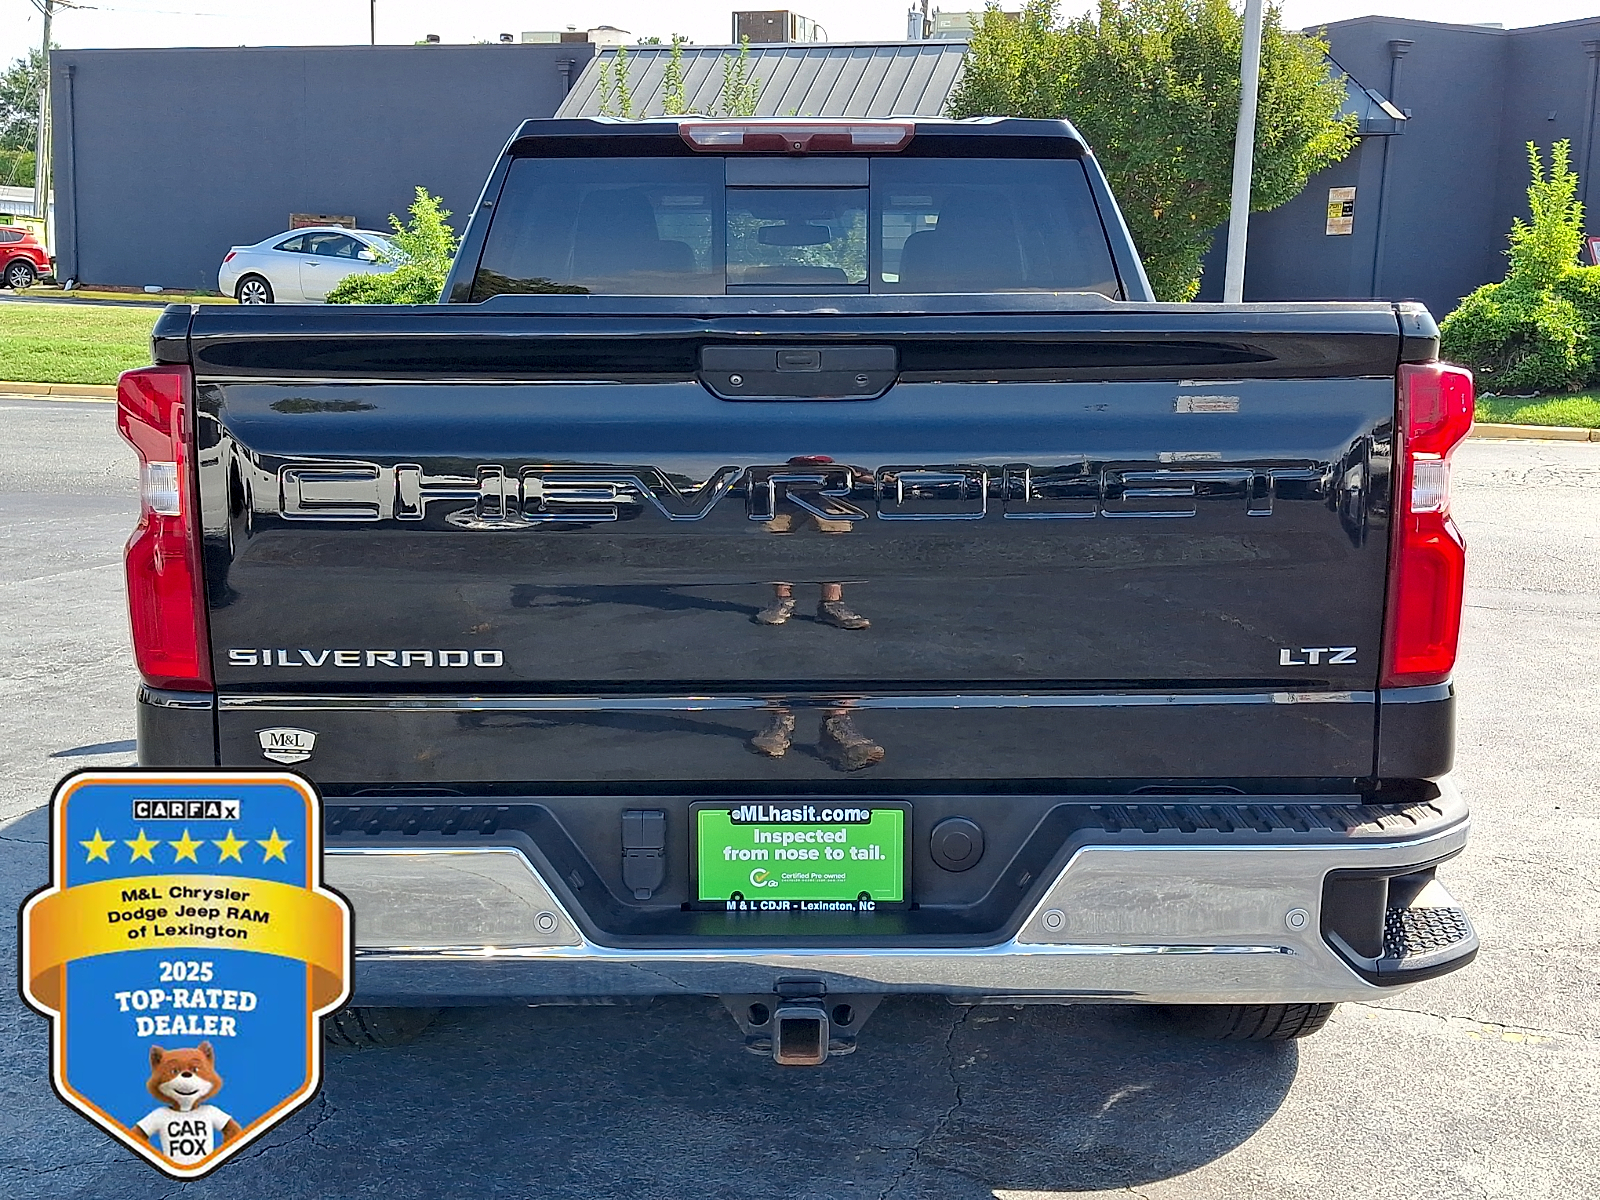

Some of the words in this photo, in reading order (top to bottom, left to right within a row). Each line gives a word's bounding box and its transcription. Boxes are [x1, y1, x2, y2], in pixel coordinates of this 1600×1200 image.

[278, 462, 1315, 522] CHEVROLET
[227, 648, 505, 668] SILVERADO
[1279, 646, 1358, 666] LTZ
[269, 732, 305, 748] M&L
[740, 805, 861, 822] MLhasit.com
[754, 828, 847, 846] Inspected
[723, 845, 769, 861] from
[774, 848, 820, 861] nose
[824, 846, 845, 861] to
[849, 844, 886, 861] tail.
[726, 901, 737, 910] M
[739, 901, 748, 910] &
[750, 901, 757, 910] L
[760, 901, 790, 910] CDJR
[859, 901, 876, 910] NC
